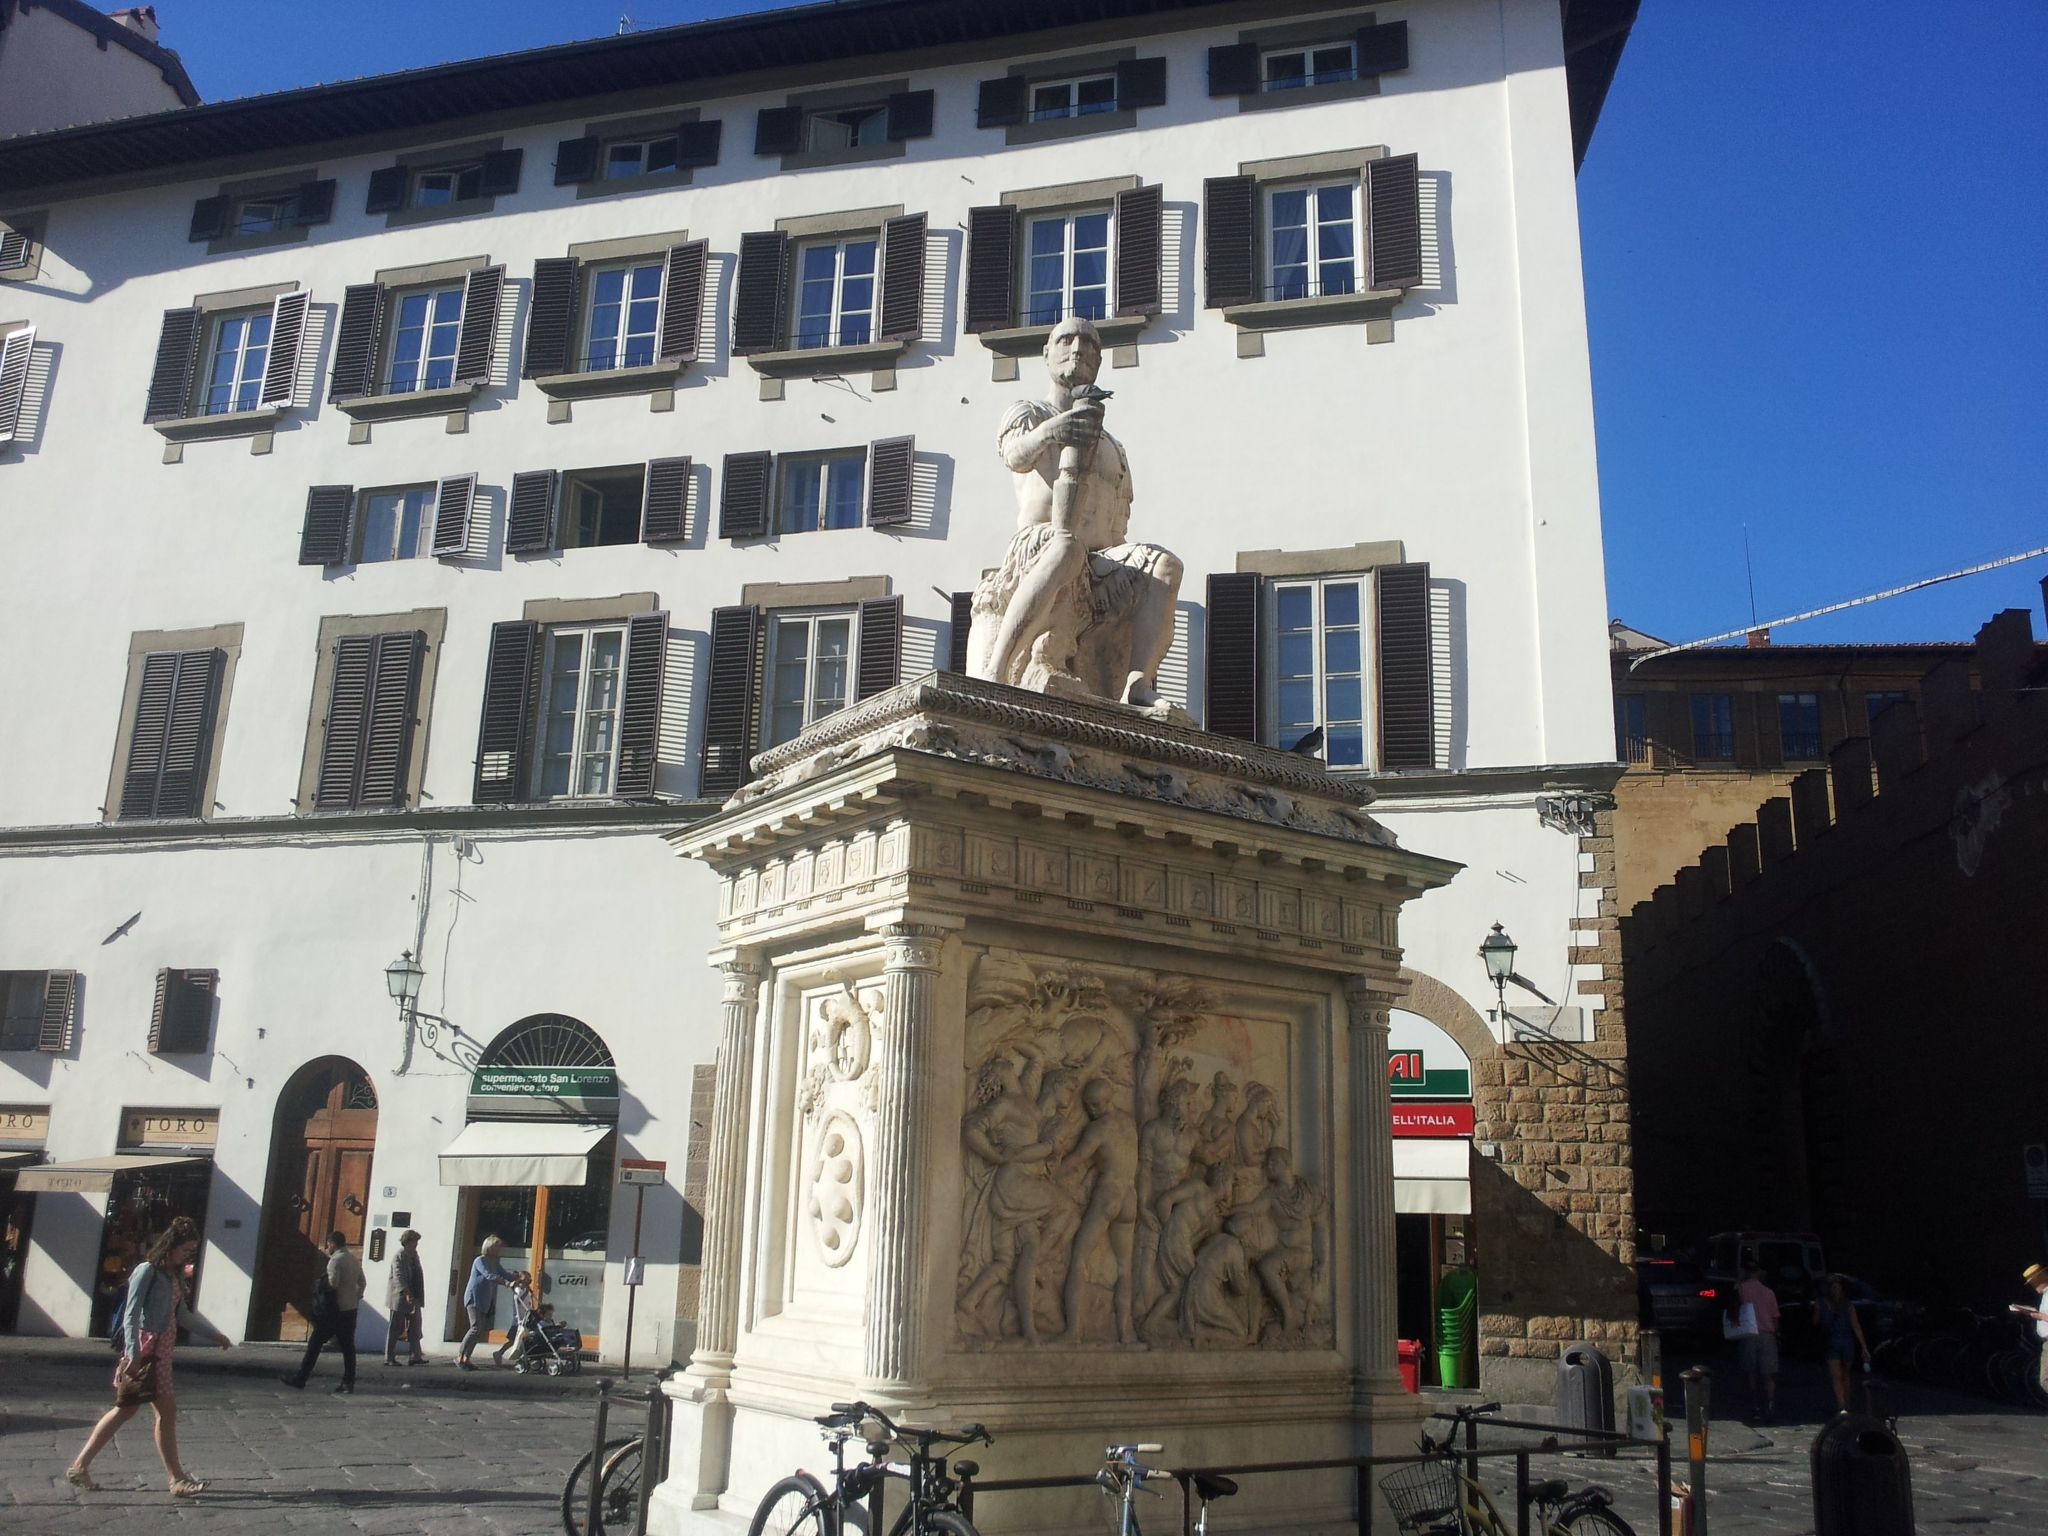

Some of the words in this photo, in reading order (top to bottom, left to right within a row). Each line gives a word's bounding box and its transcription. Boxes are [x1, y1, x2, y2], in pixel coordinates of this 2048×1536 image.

[1387, 1053, 1420, 1078] AI
[481, 1073, 548, 1084] supermercato
[549, 1073, 568, 1084] San
[571, 1073, 609, 1084] Lorenzo
[480, 1082, 535, 1091] convenience
[536, 1083, 560, 1092] store
[0, 1114, 33, 1128] RO
[145, 1117, 206, 1132] TORO
[1392, 1115, 1456, 1125] ELL'ITALIA
